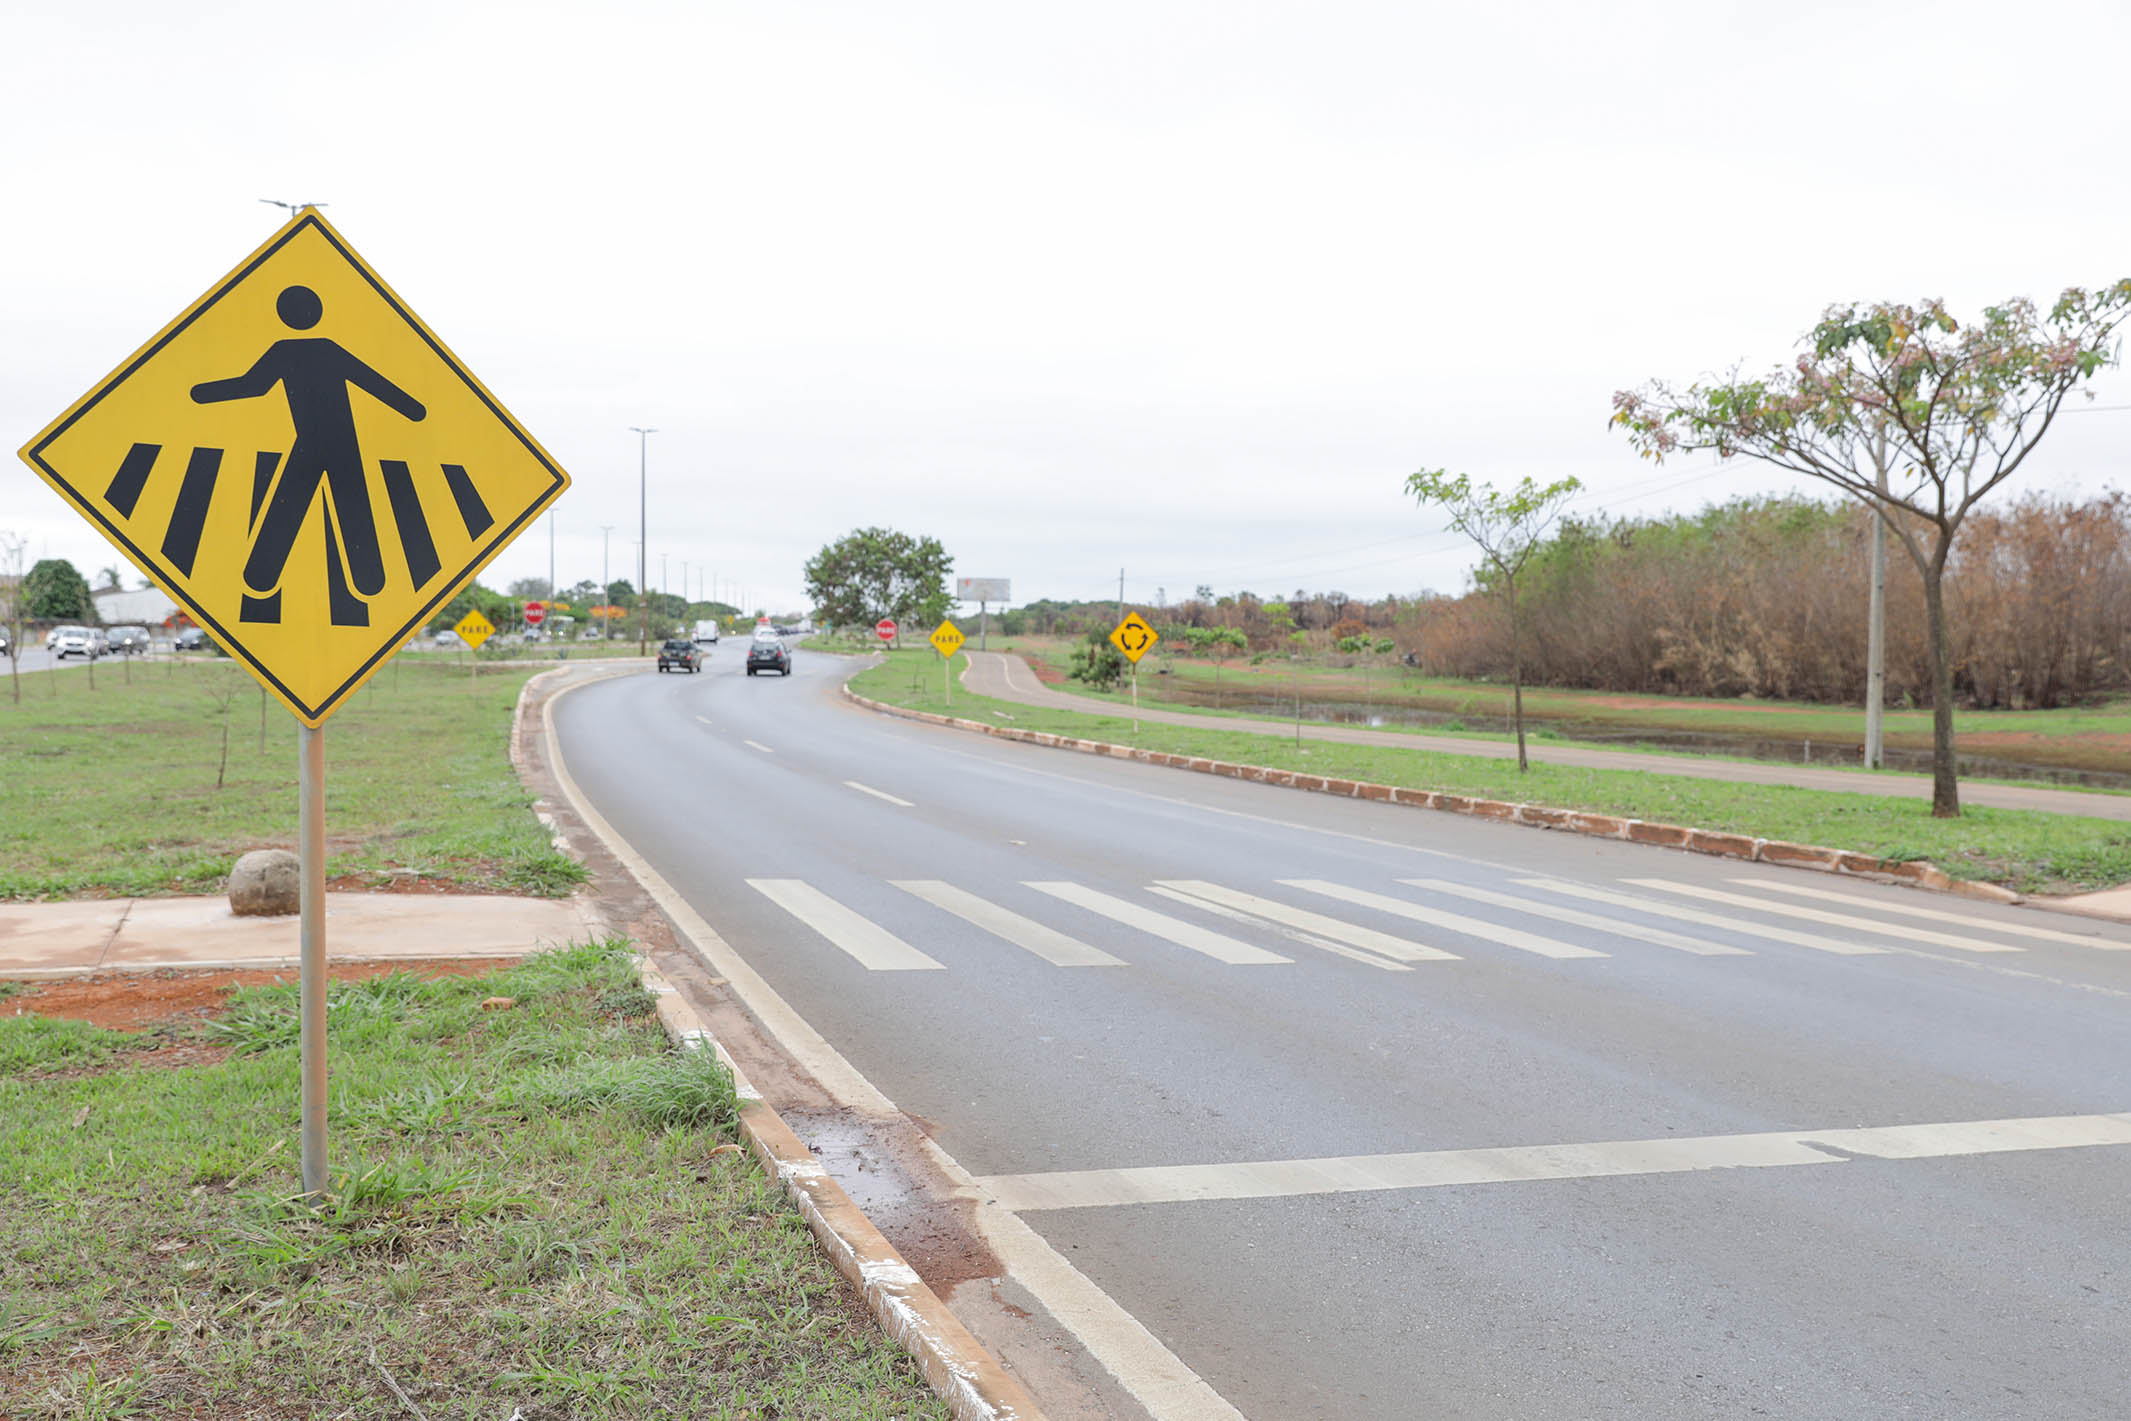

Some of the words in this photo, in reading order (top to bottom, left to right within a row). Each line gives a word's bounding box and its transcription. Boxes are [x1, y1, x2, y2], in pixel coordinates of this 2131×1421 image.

[526, 609, 544, 617] PARE
[461, 626, 487, 634] PARE
[935, 635, 960, 643] PARE
